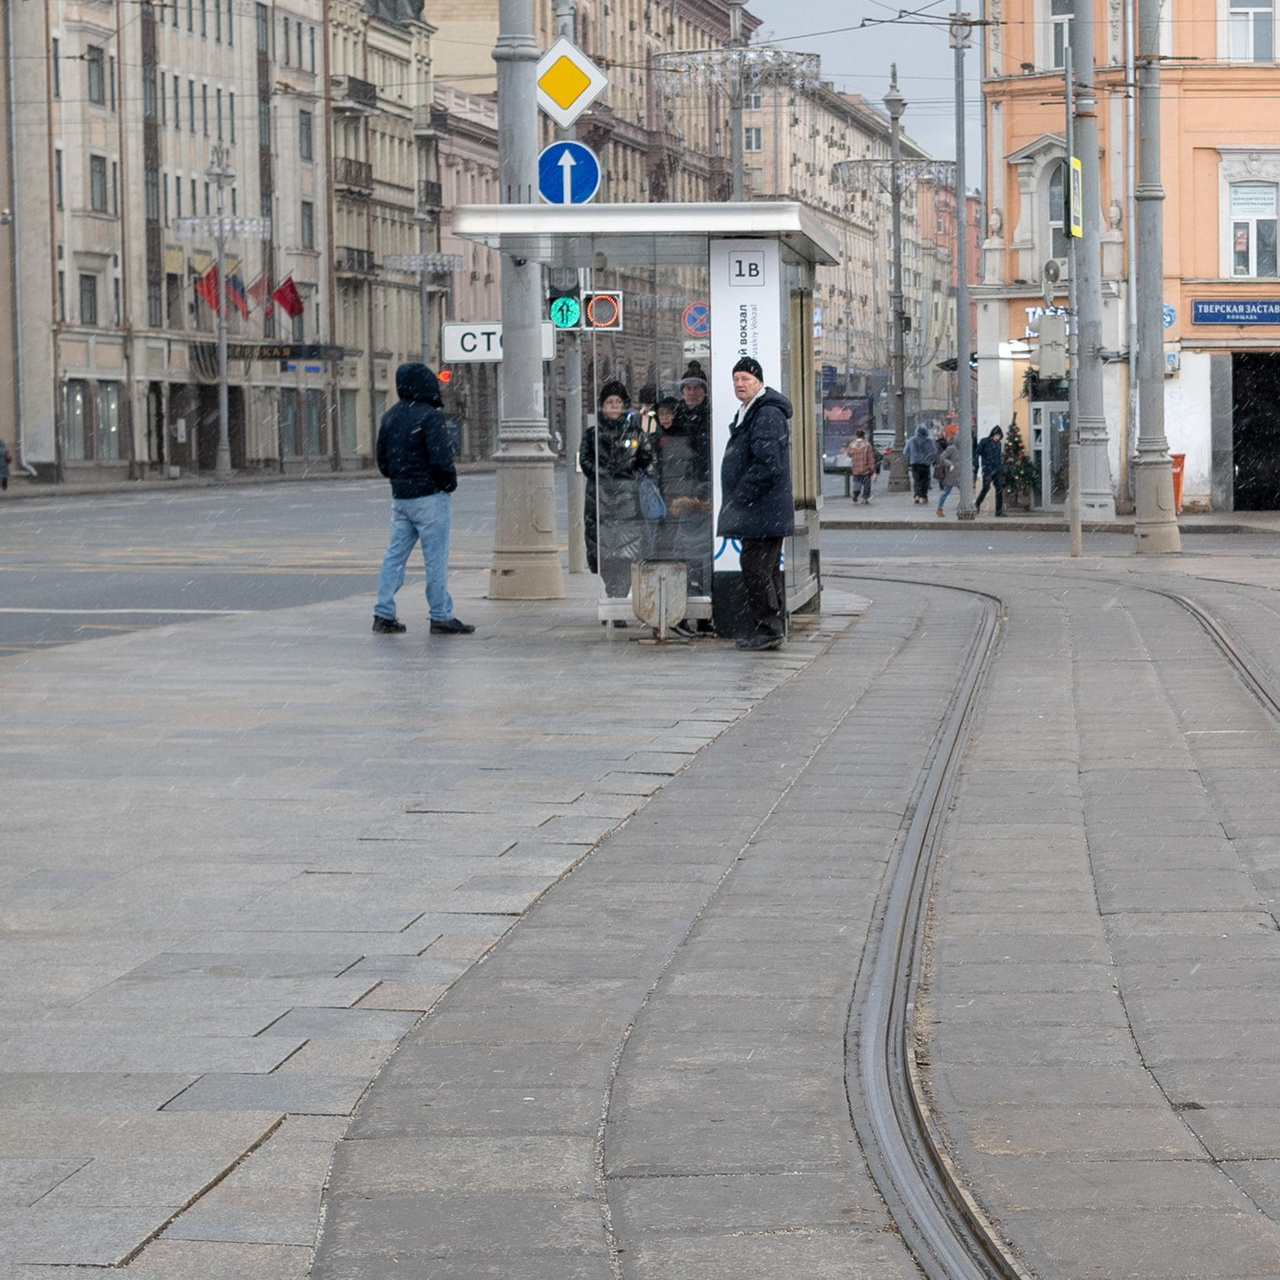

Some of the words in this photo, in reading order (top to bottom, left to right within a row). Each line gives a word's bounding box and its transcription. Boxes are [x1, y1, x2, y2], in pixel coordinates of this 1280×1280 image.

[1197, 304, 1244, 313] ТВЕРСКАЯ
[739, 304, 748, 345] вокзал
[460, 332, 503, 352] СТ
[750, 330, 759, 360] russkiy
